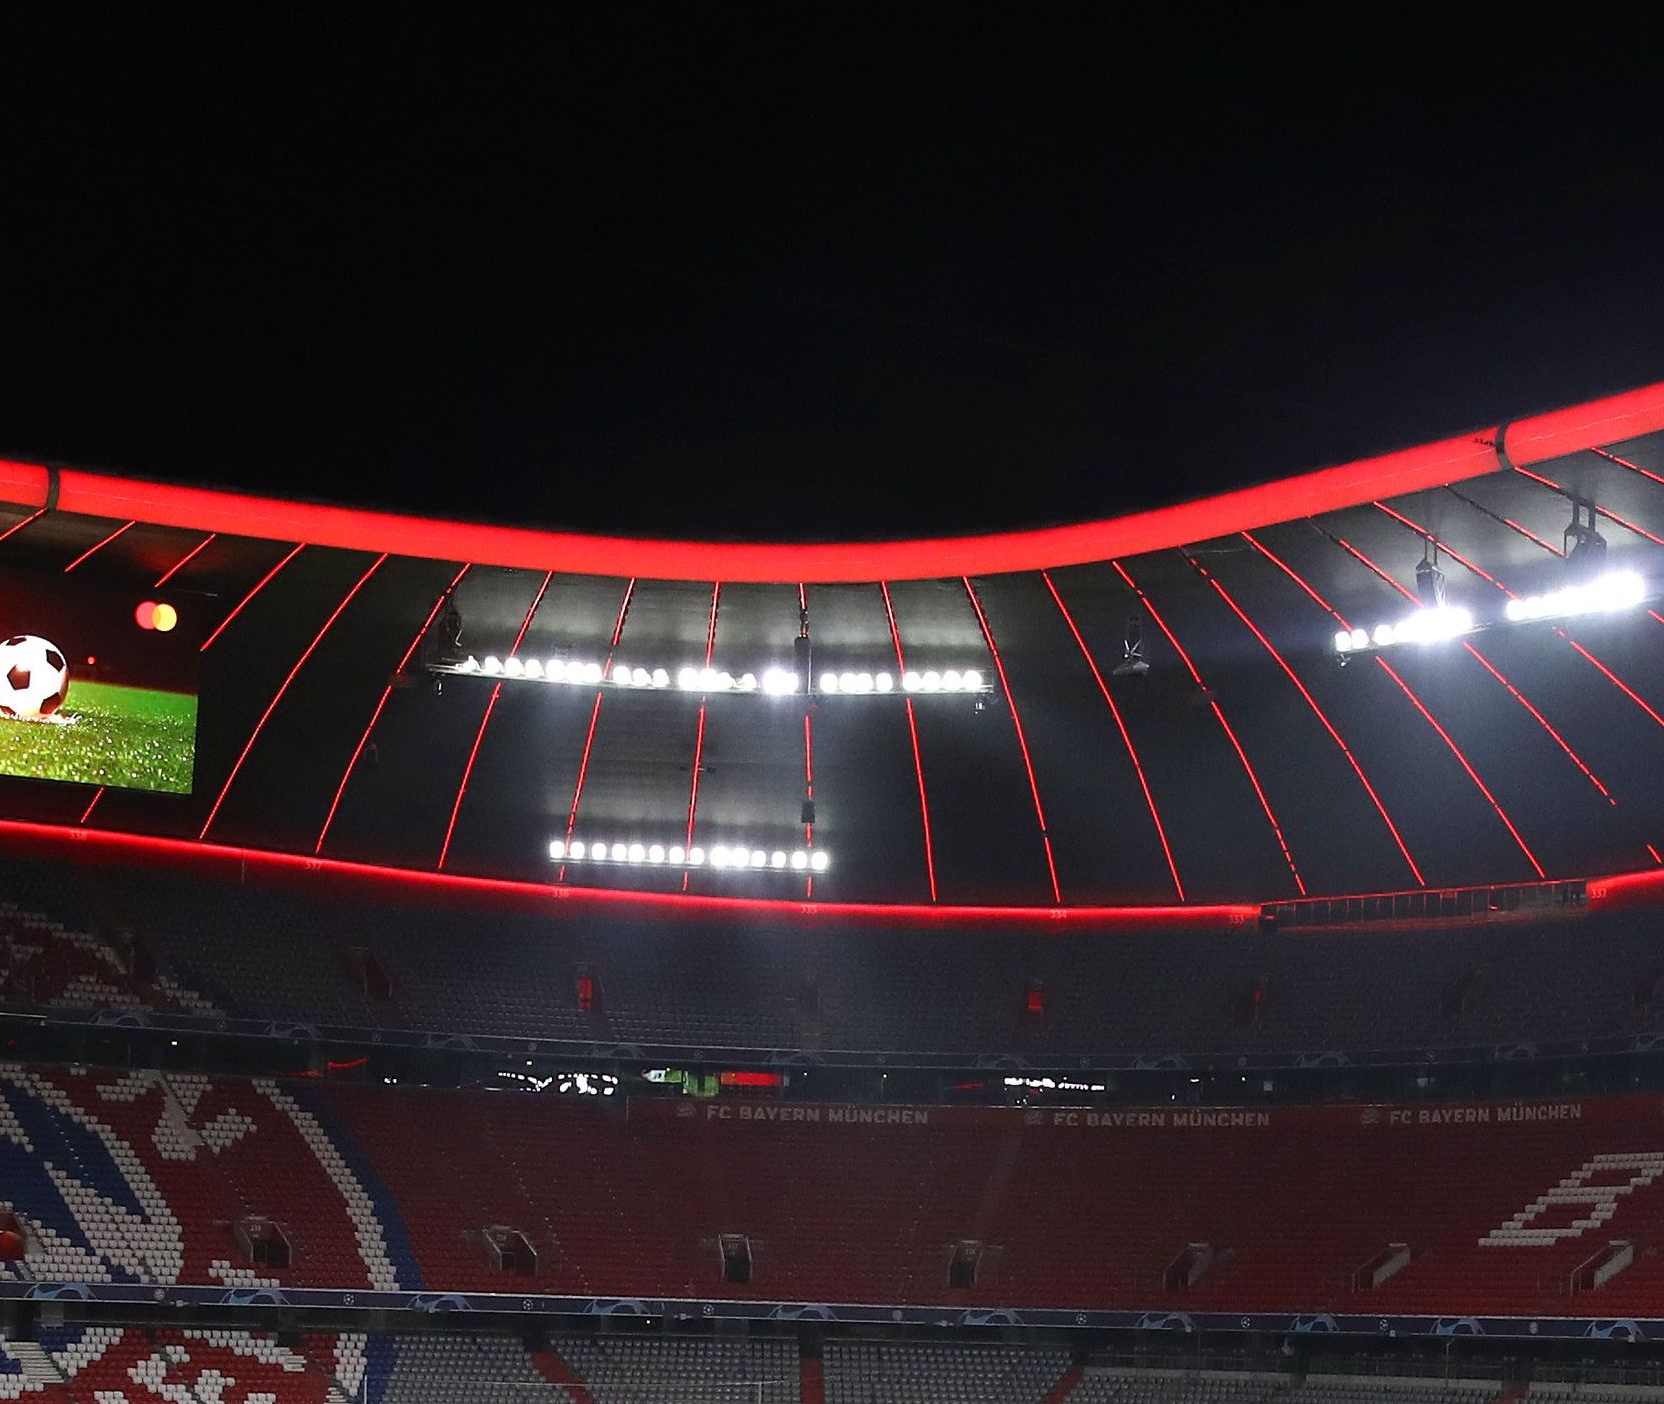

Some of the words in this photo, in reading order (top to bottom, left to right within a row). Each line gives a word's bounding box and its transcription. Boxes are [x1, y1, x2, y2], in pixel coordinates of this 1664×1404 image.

[706, 1105, 733, 1121] FC
[739, 1106, 820, 1124] BAYERN
[828, 1105, 929, 1125] MÜNCHEN
[1053, 1112, 1079, 1127] FC
[1084, 1112, 1165, 1128] BAYERN
[1172, 1108, 1270, 1129] MÜNCHEN
[1389, 1110, 1412, 1125] FC
[1418, 1107, 1490, 1124] BAYERN
[1497, 1101, 1582, 1122] MÜNCHEN
